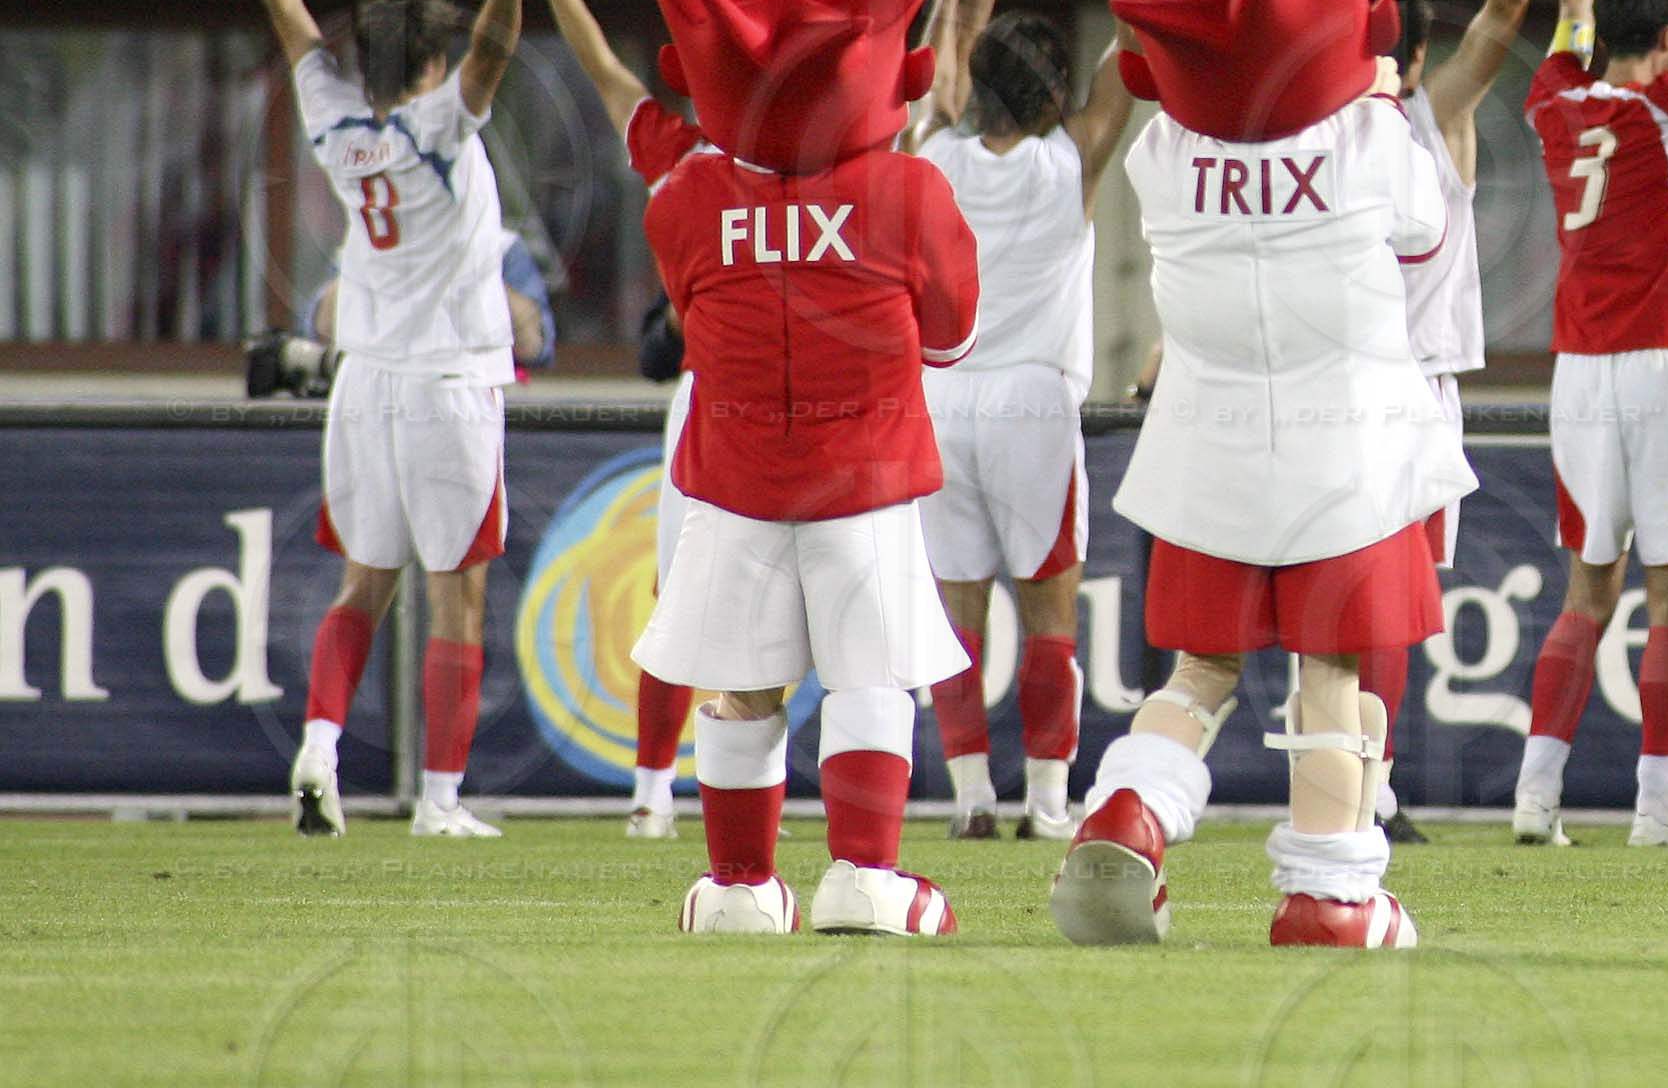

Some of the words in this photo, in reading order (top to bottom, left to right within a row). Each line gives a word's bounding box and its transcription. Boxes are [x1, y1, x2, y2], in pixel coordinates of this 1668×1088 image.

[1192, 156, 1329, 215] TRIX
[1563, 126, 1618, 231] 3
[721, 204, 857, 266] FLIX
